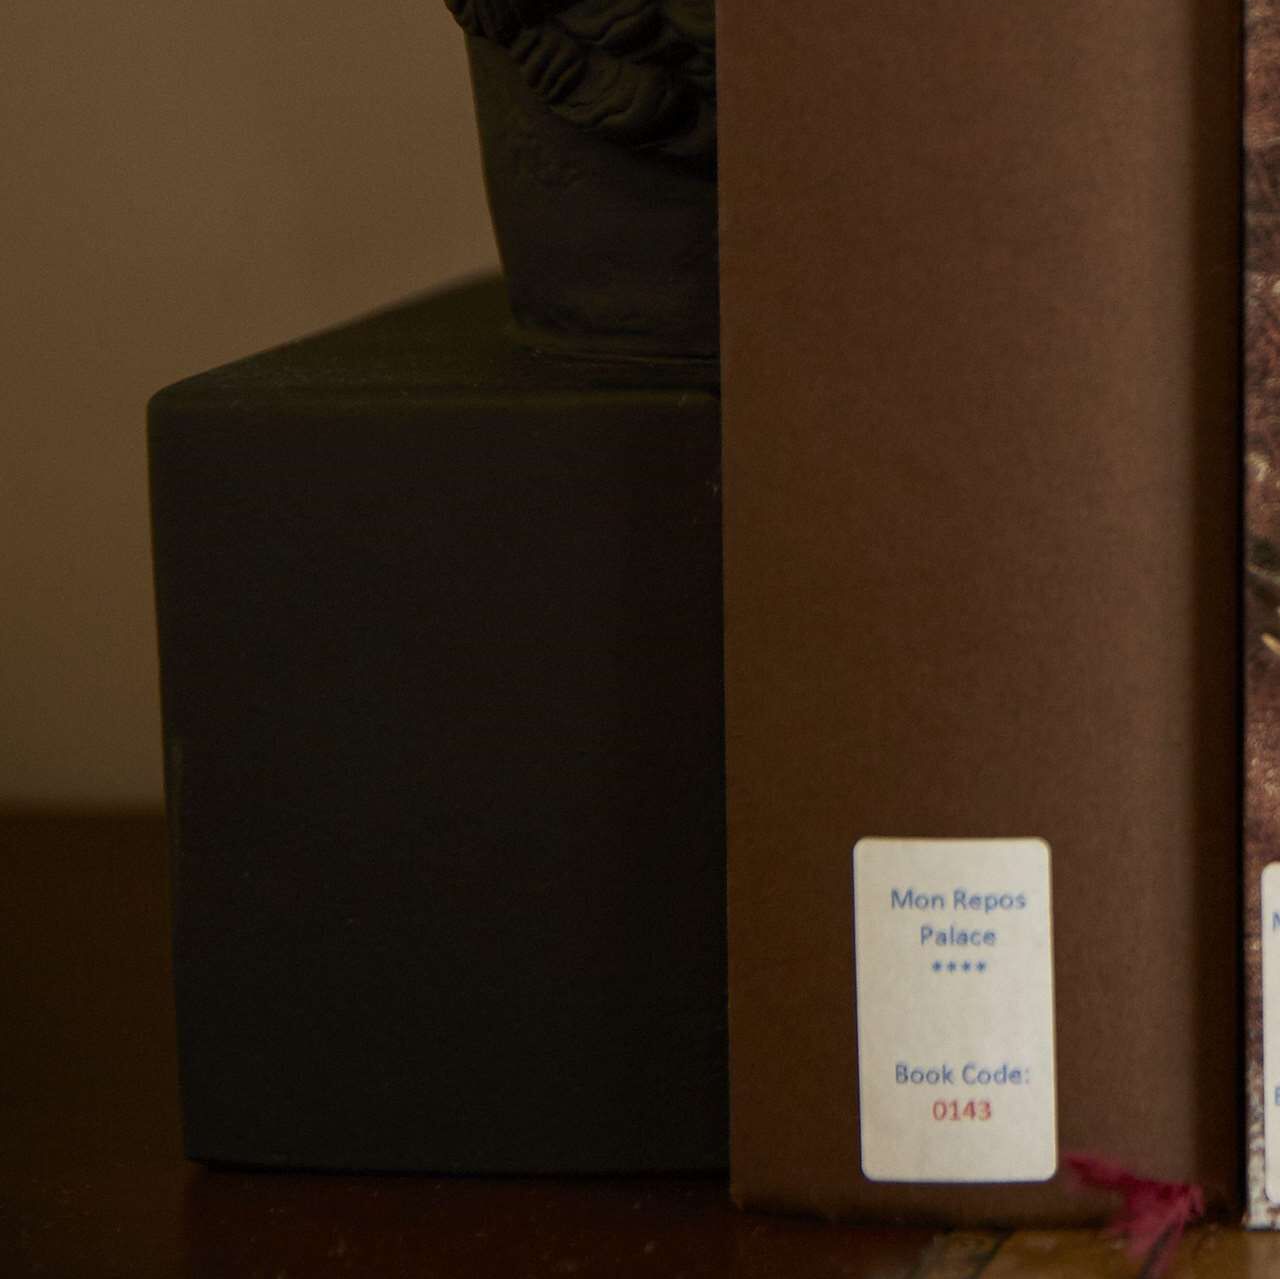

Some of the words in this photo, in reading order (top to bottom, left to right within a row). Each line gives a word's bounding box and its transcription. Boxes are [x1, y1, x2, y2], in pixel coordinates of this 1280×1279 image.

[891, 889, 945, 910] Mon
[953, 889, 1026, 913] Repos
[920, 926, 997, 946] Palace
[895, 1064, 953, 1085] Book
[962, 1064, 1030, 1085] Code:
[932, 1100, 992, 1121] 0143
